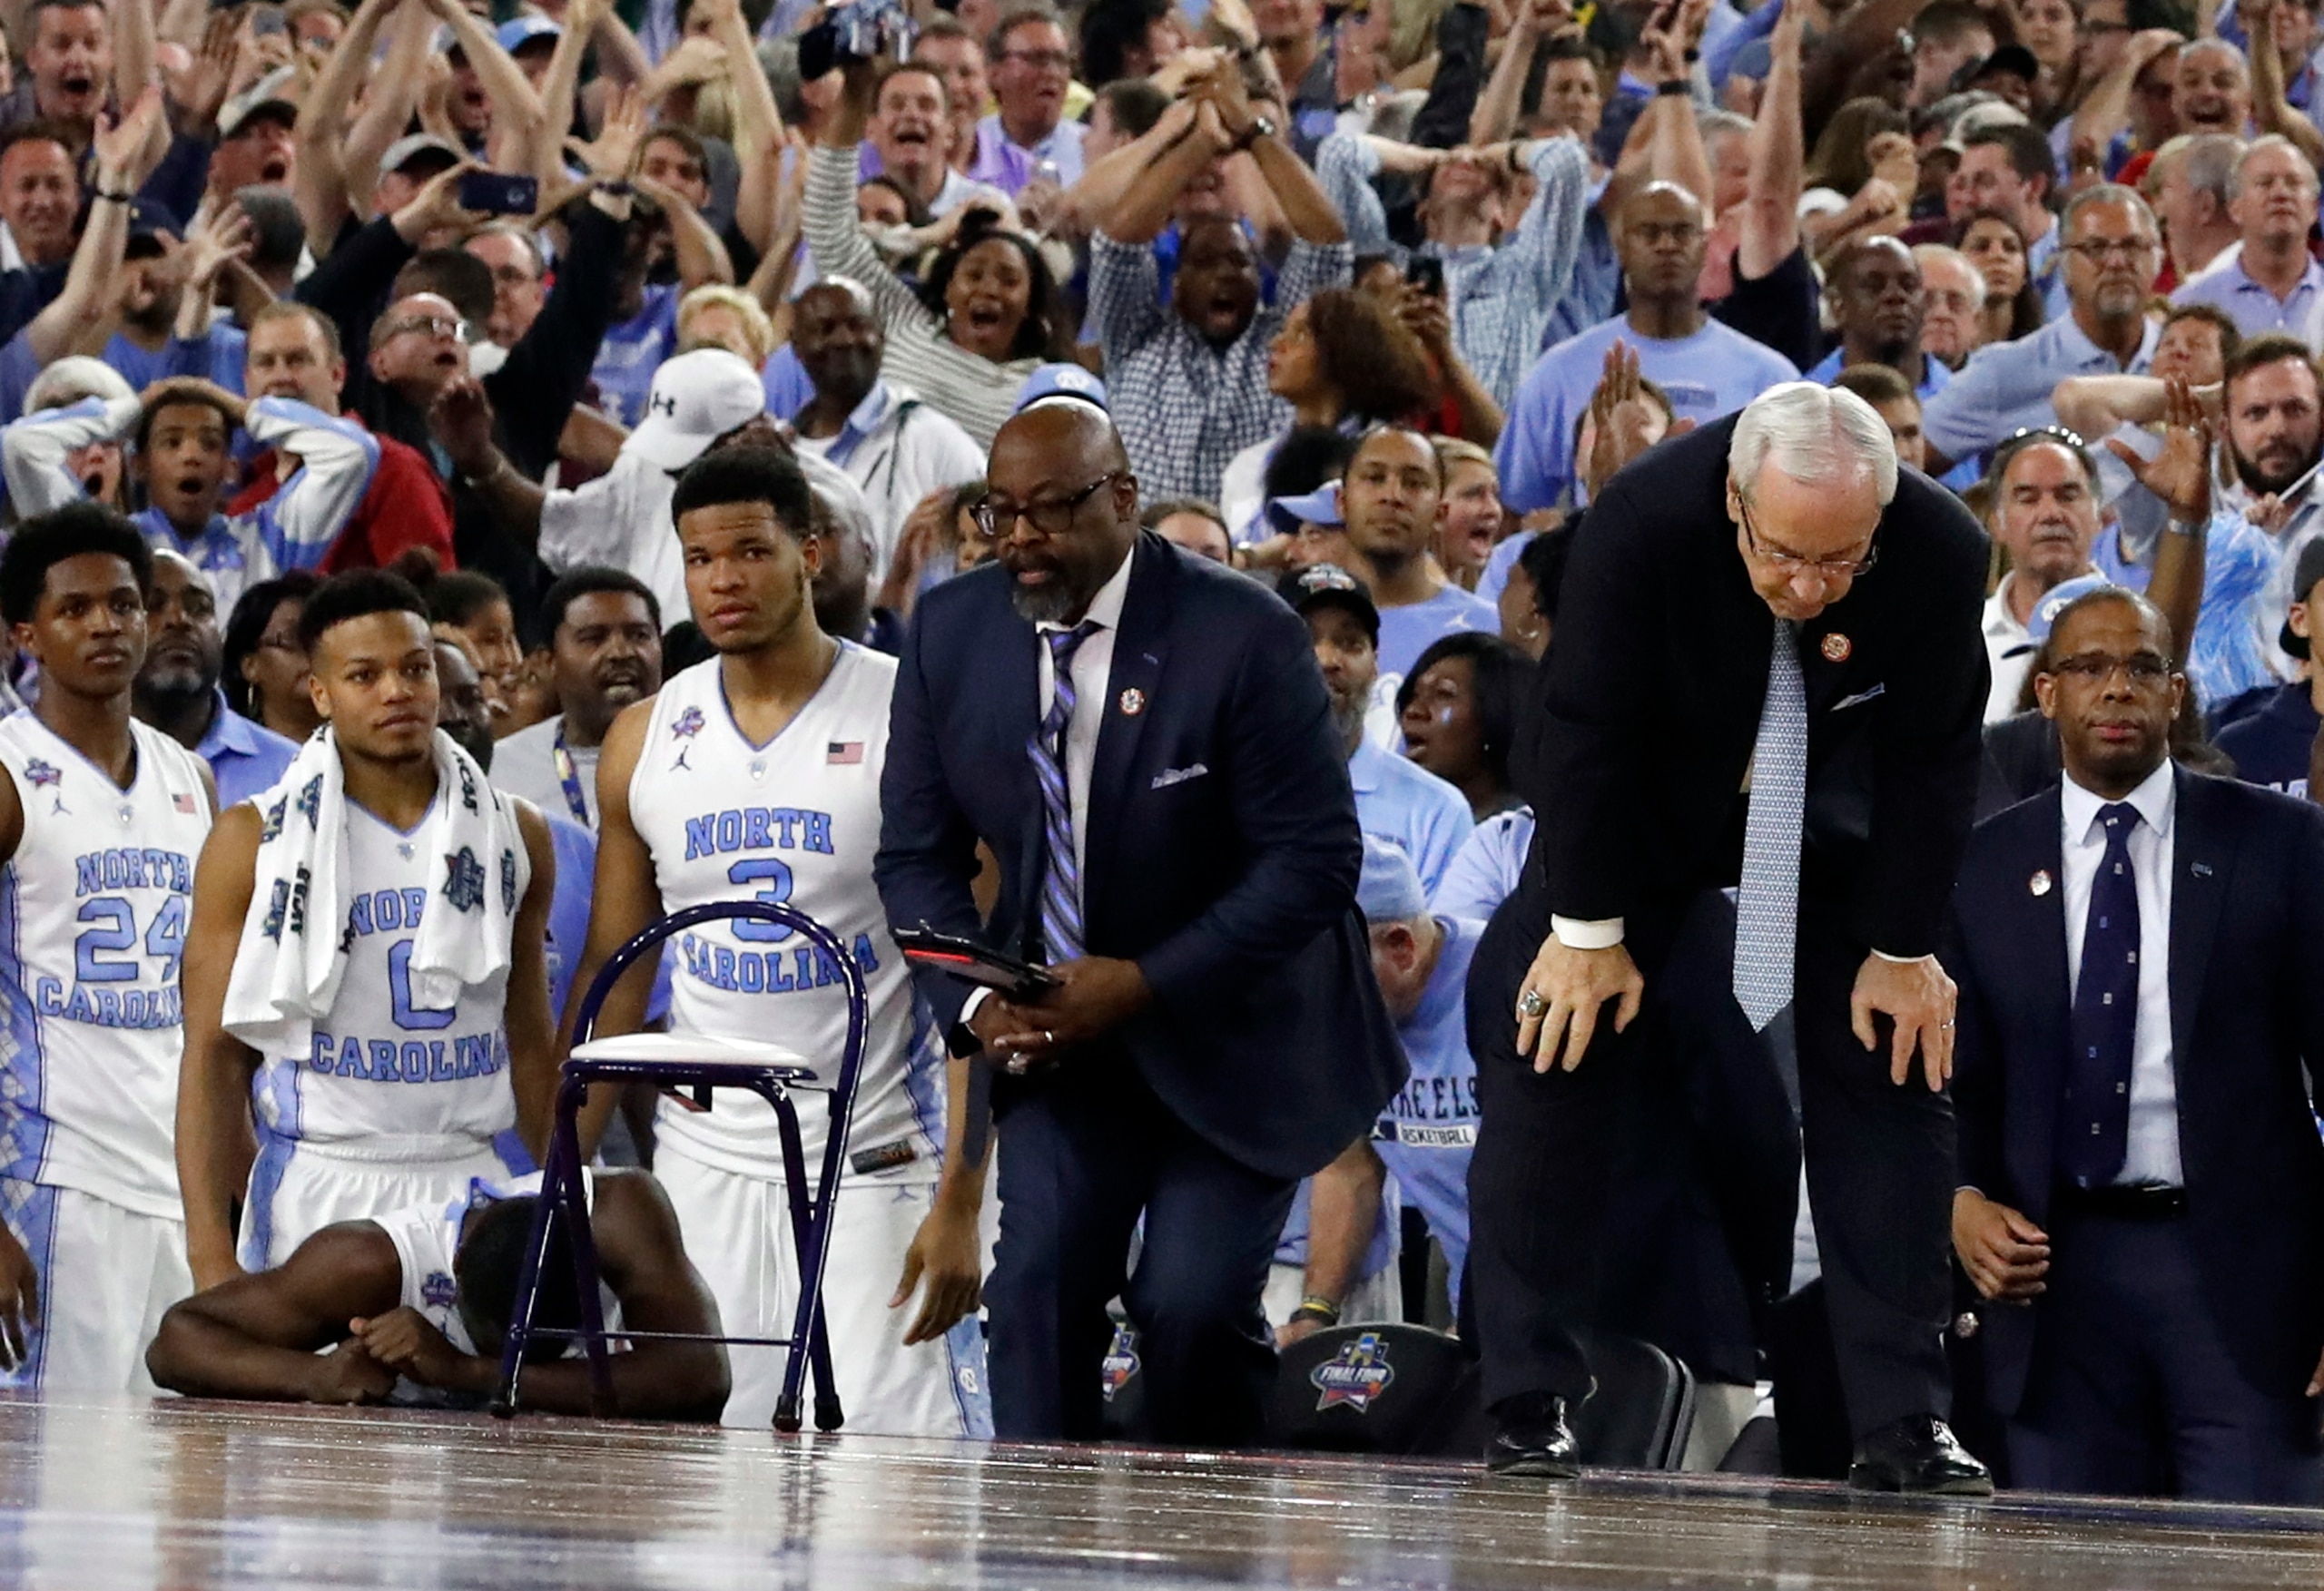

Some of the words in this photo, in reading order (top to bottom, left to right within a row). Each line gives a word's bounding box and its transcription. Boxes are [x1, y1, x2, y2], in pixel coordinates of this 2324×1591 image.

[685, 807, 834, 861] NORTH
[75, 848, 192, 898] NORTH
[350, 887, 428, 936] NOR
[728, 858, 793, 942] 3
[75, 895, 186, 982] 24
[37, 977, 183, 1029] CAROLIN
